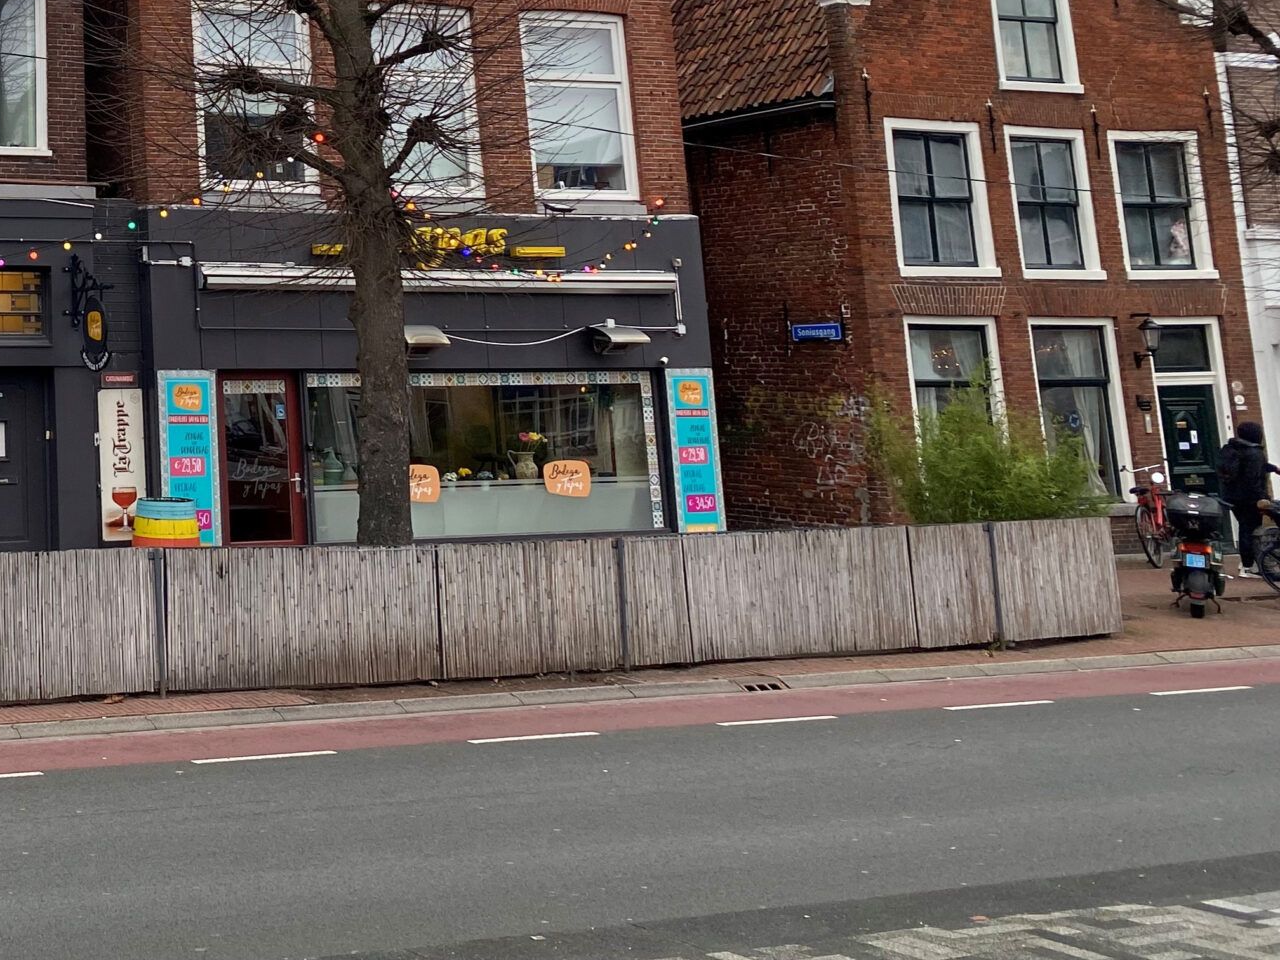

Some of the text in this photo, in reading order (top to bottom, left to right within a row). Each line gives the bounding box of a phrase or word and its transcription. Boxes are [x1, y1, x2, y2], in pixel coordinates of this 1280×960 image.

[112, 400, 132, 456] Trappe
[113, 455, 134, 478] La
[232, 458, 279, 480] Bodega
[548, 463, 580, 481] Bodega
[243, 471, 283, 500] y Tapas
[561, 472, 583, 495] Tapas
